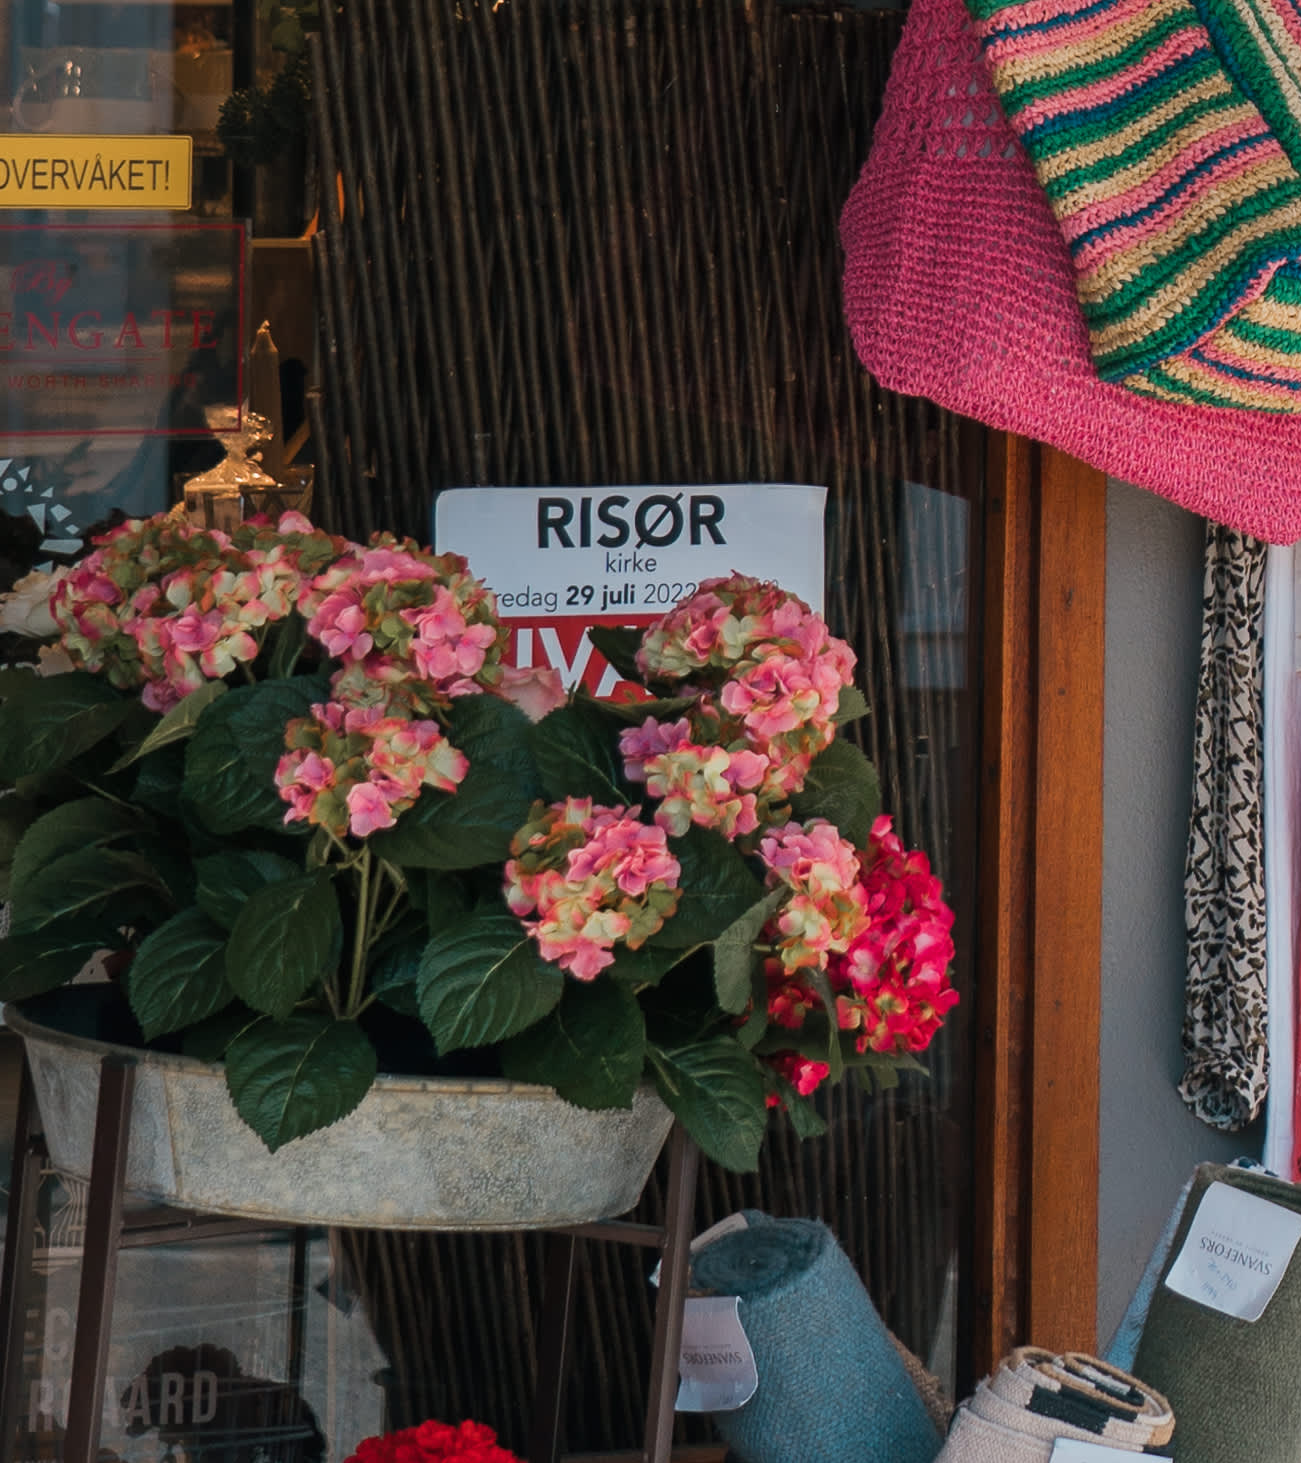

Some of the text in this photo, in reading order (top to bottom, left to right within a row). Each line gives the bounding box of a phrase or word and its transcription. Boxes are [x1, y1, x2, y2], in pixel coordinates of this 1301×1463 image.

[537, 492, 727, 550] RISØR
[605, 551, 658, 574] kirke
[484, 585, 558, 612] redag
[566, 584, 595, 606] 29
[601, 582, 636, 612] juli
[1199, 1236, 1273, 1276] SVANEFORS
